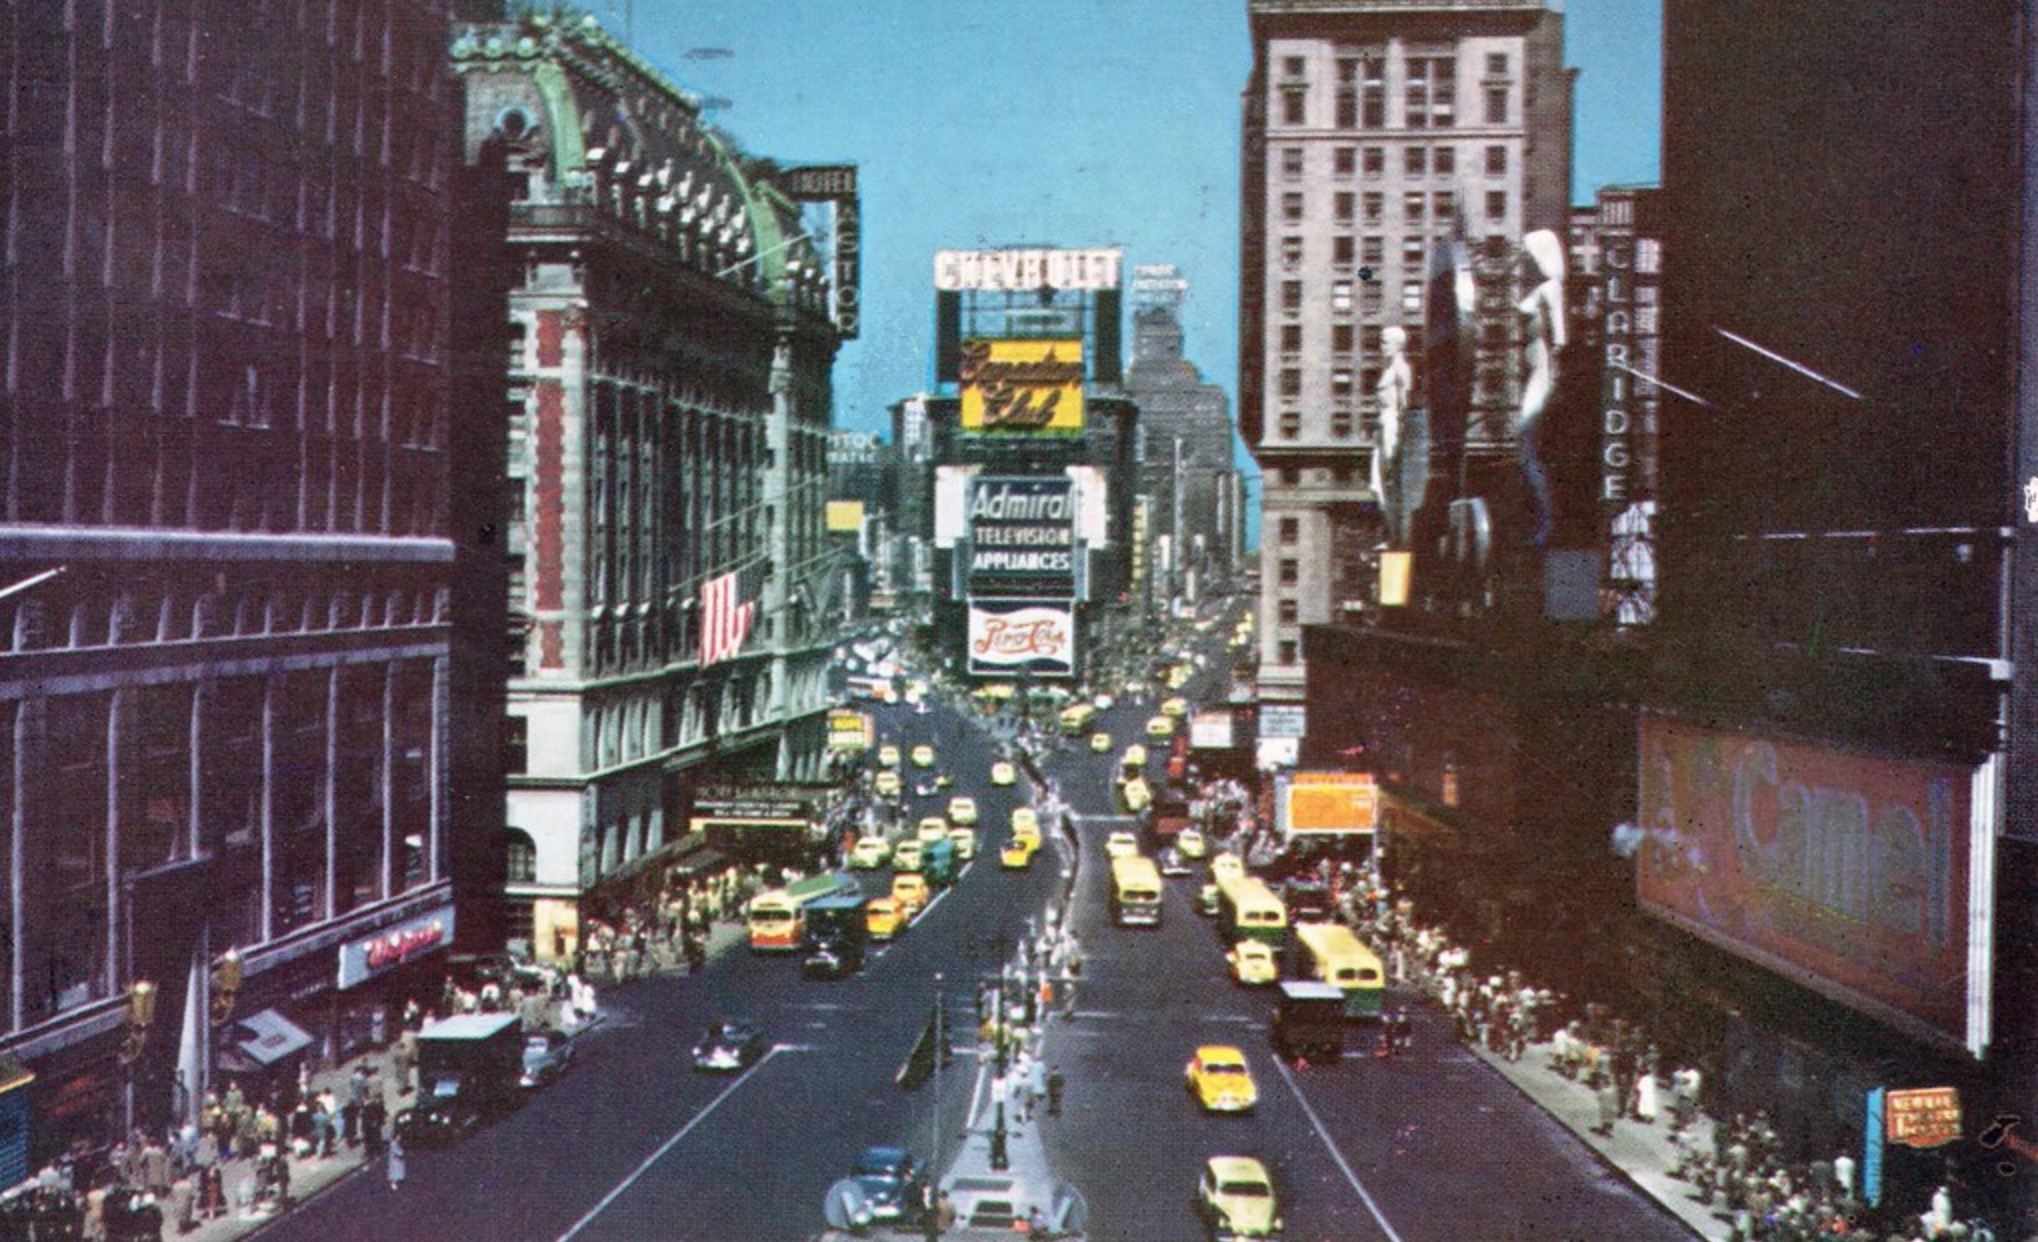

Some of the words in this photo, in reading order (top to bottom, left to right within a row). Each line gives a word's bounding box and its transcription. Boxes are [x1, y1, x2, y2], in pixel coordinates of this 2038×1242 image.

[1604, 246, 1630, 499] CLARIDGE
[980, 381, 1062, 428] Club
[970, 484, 1073, 519] Admiral
[976, 527, 1070, 544] TELEVISION
[972, 553, 1070, 570] APPLIANCES
[1732, 741, 1952, 956] Camel
